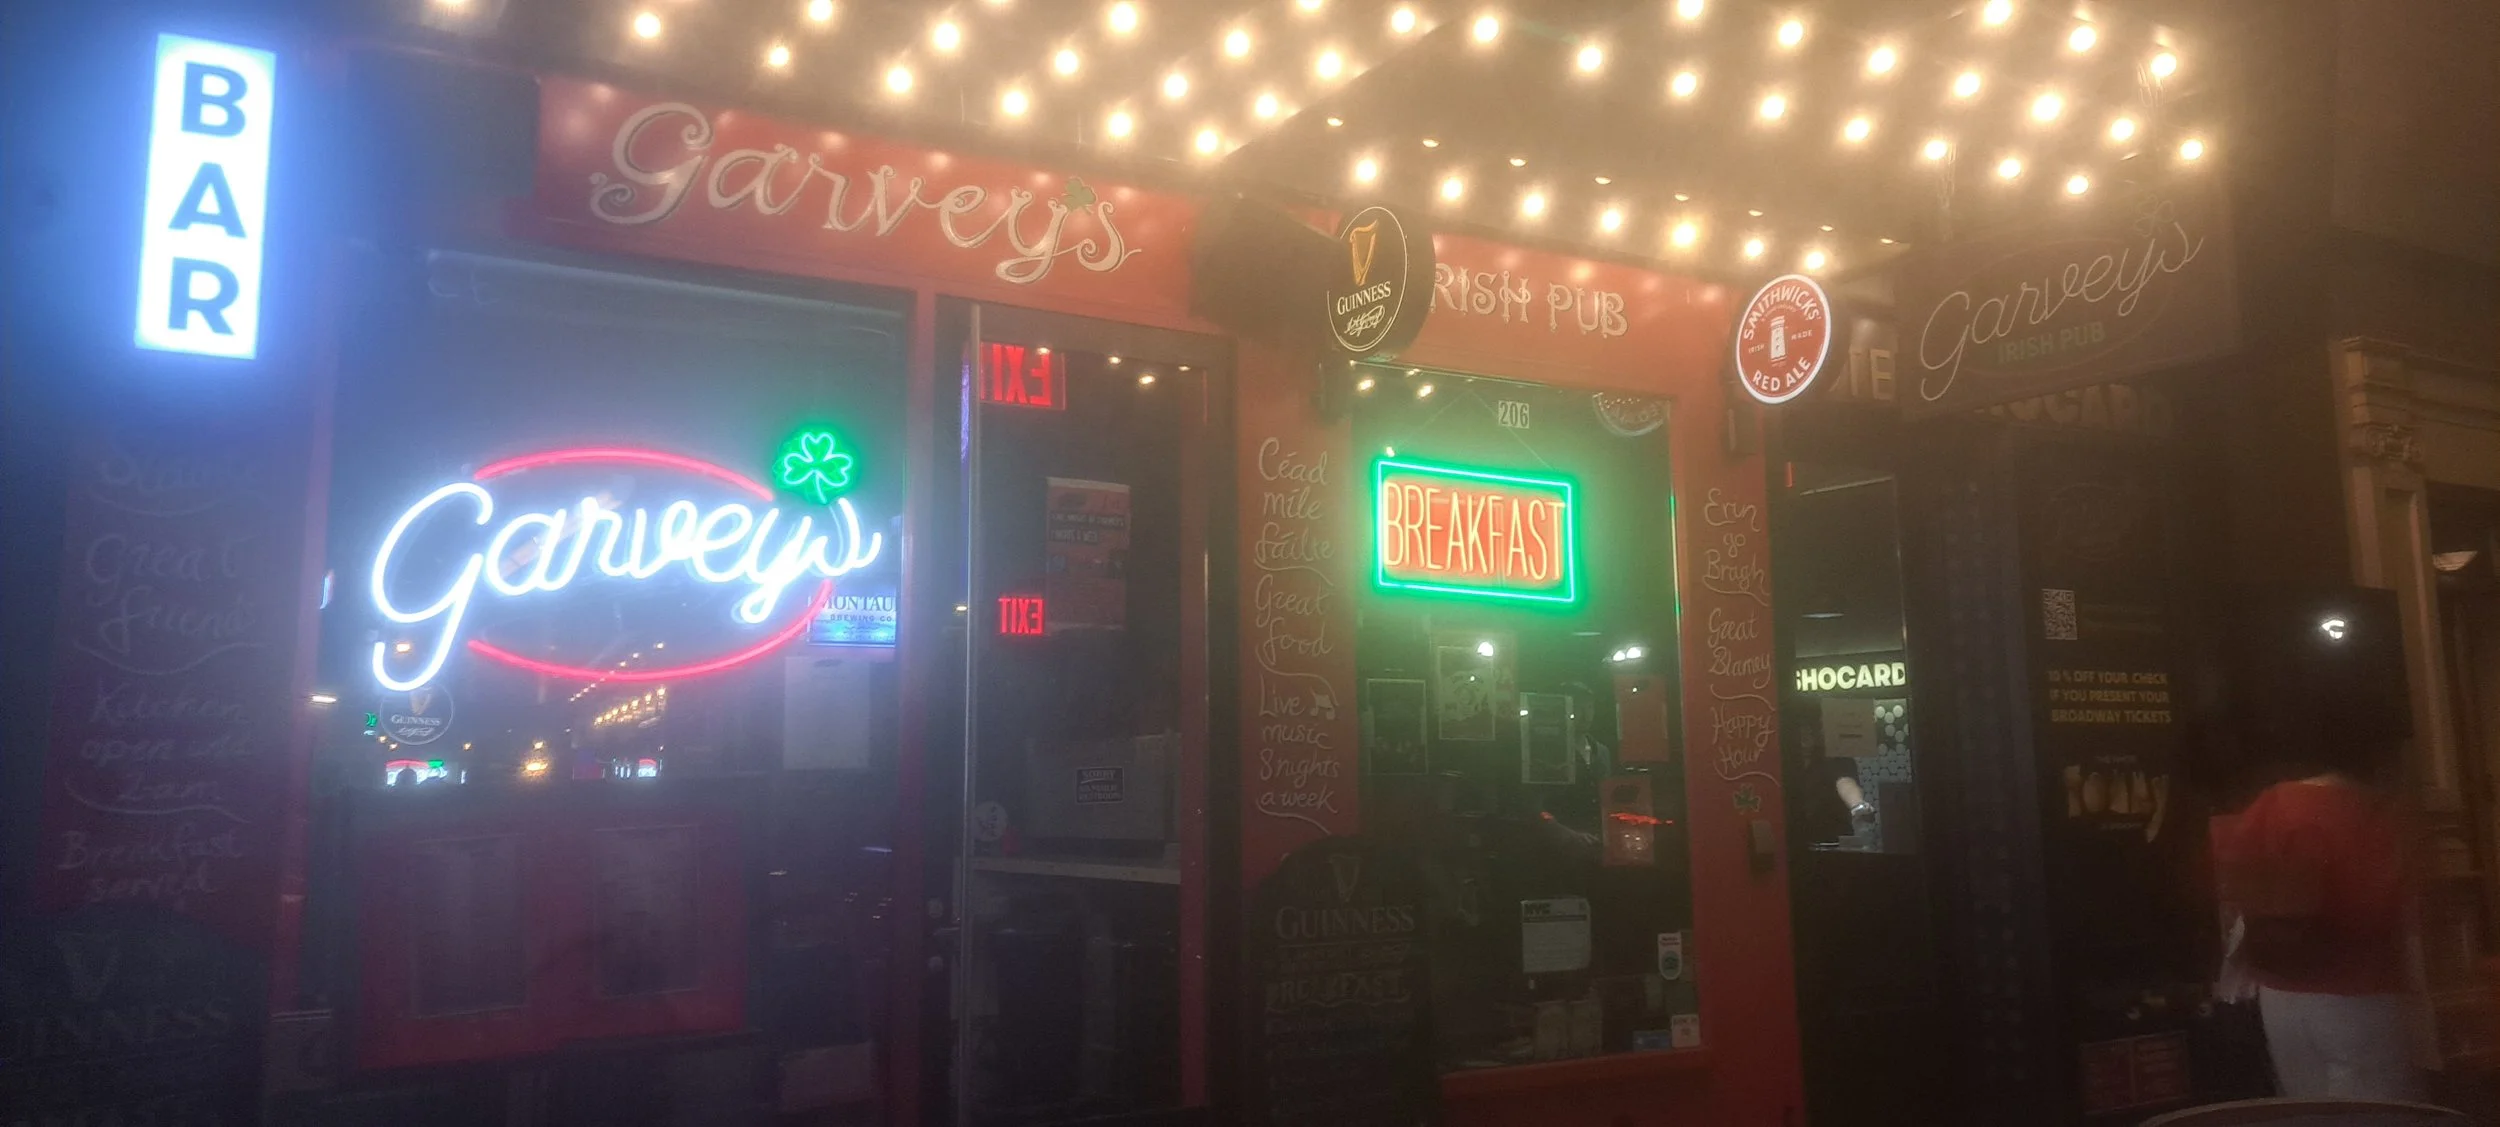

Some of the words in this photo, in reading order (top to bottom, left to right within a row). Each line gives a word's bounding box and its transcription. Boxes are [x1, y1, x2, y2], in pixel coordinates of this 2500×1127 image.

[168, 61, 248, 336] BAR
[1337, 281, 1392, 316] GUINNESS
[1547, 283, 1628, 338] PUB
[1998, 334, 2053, 363] IRISH
[2061, 322, 2106, 352] PUB
[1753, 369, 1781, 392] RED
[1786, 356, 1811, 387] ALE
[1500, 403, 1528, 428] 206
[1704, 488, 1760, 532] Erin
[1384, 482, 1566, 581] BREAKFAST
[1723, 533, 1746, 558] go
[1703, 549, 1770, 596] Bragh
[830, 613, 875, 622] BREWING
[1255, 574, 1331, 627] Great
[1263, 617, 1333, 665] food
[1708, 607, 1760, 647] Great
[2074, 670, 2095, 682] OFF
[2098, 671, 2128, 683] YOUR
[1259, 673, 1304, 717] Live
[2062, 689, 2087, 701] YOU
[2090, 690, 2138, 701] PRESENT
[2139, 691, 2170, 703] YOUR
[391, 714, 441, 726] GUINNESS
[1710, 702, 1775, 748] Happy
[2051, 709, 2121, 722] BROADWAY
[2124, 710, 2172, 723] TICKETS
[1261, 723, 1334, 750] music
[1276, 750, 1340, 788] nights
[1719, 747, 1764, 774] Hour
[1262, 791, 1275, 806] a
[1280, 783, 1338, 814] week
[1276, 904, 1416, 939] GUINNESS
